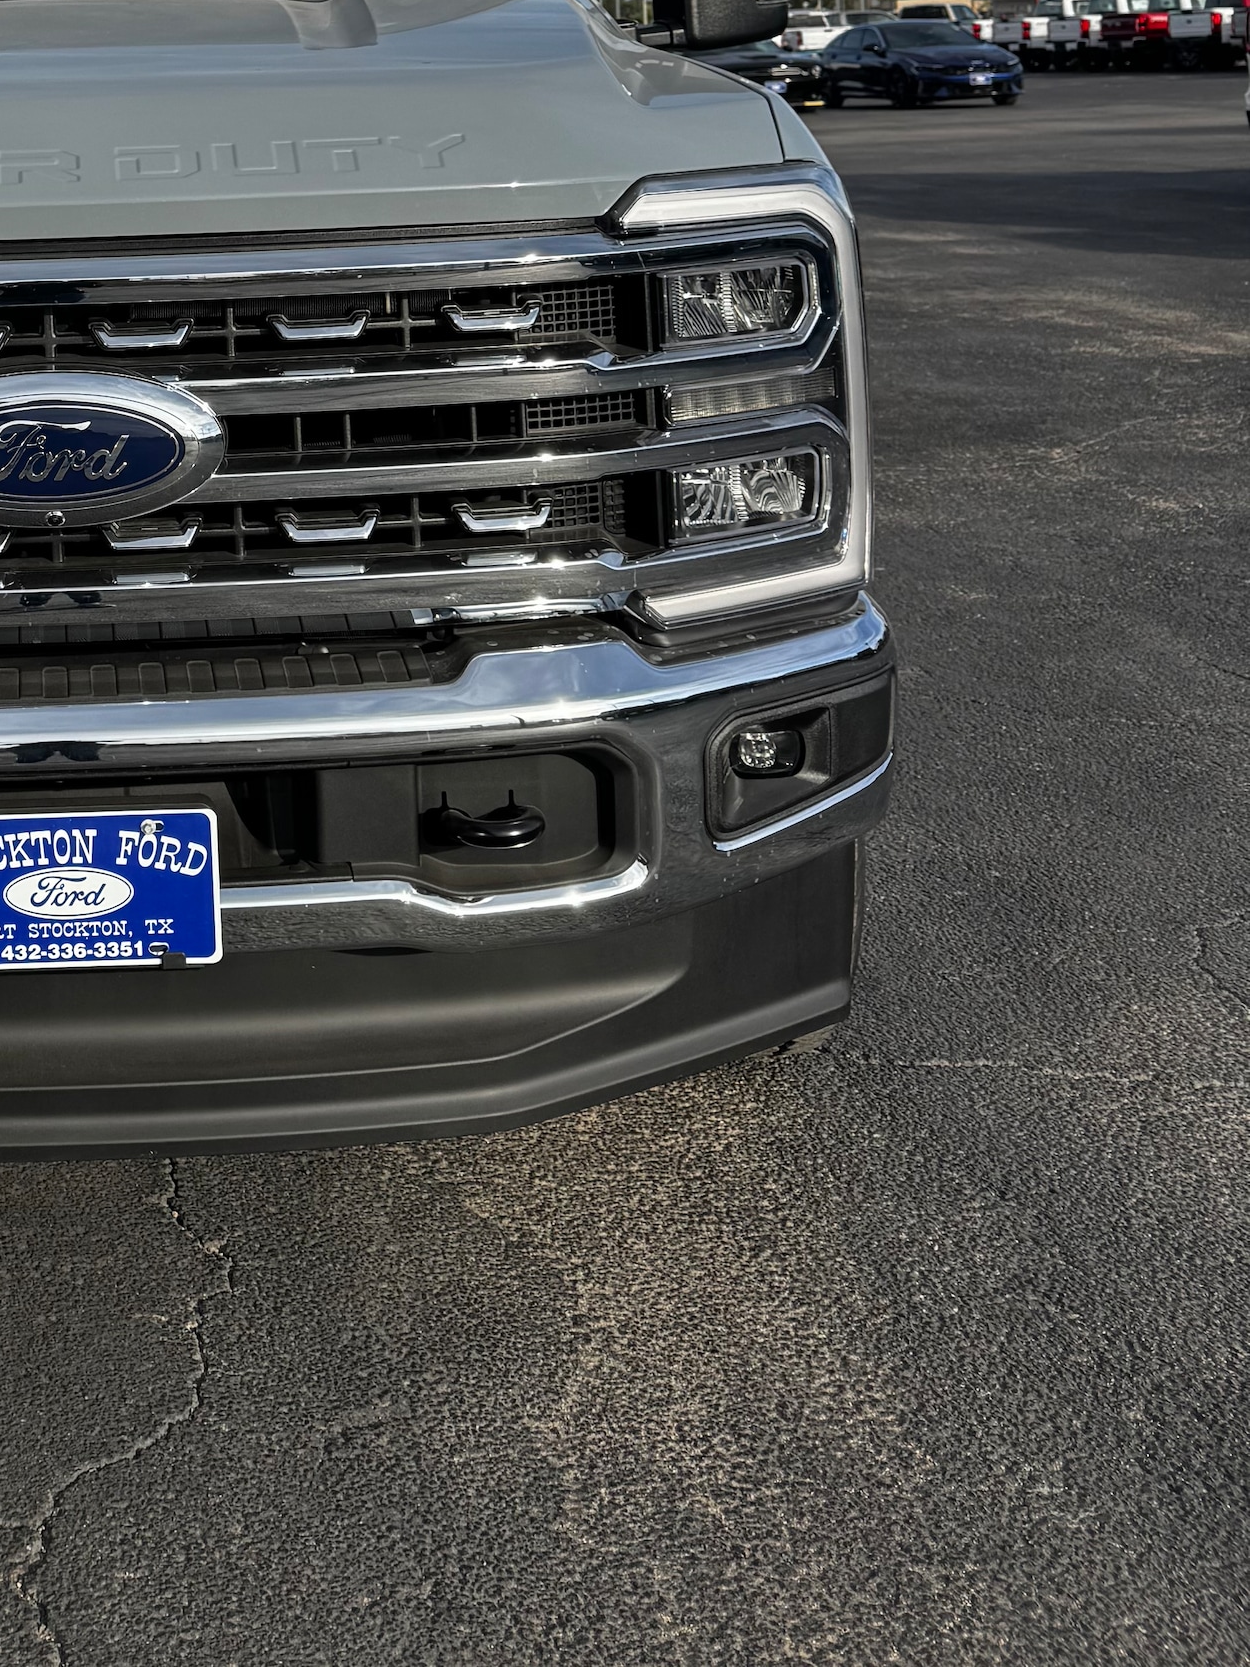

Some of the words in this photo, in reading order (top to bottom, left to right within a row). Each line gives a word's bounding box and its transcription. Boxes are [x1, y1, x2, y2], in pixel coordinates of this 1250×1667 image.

[114, 133, 465, 182] DUTY
[115, 830, 208, 877] FORD
[30, 875, 107, 908] Ford
[28, 920, 134, 939] STOCKTON,
[144, 918, 175, 935] TX
[1, 940, 144, 961] 432-336-3351
